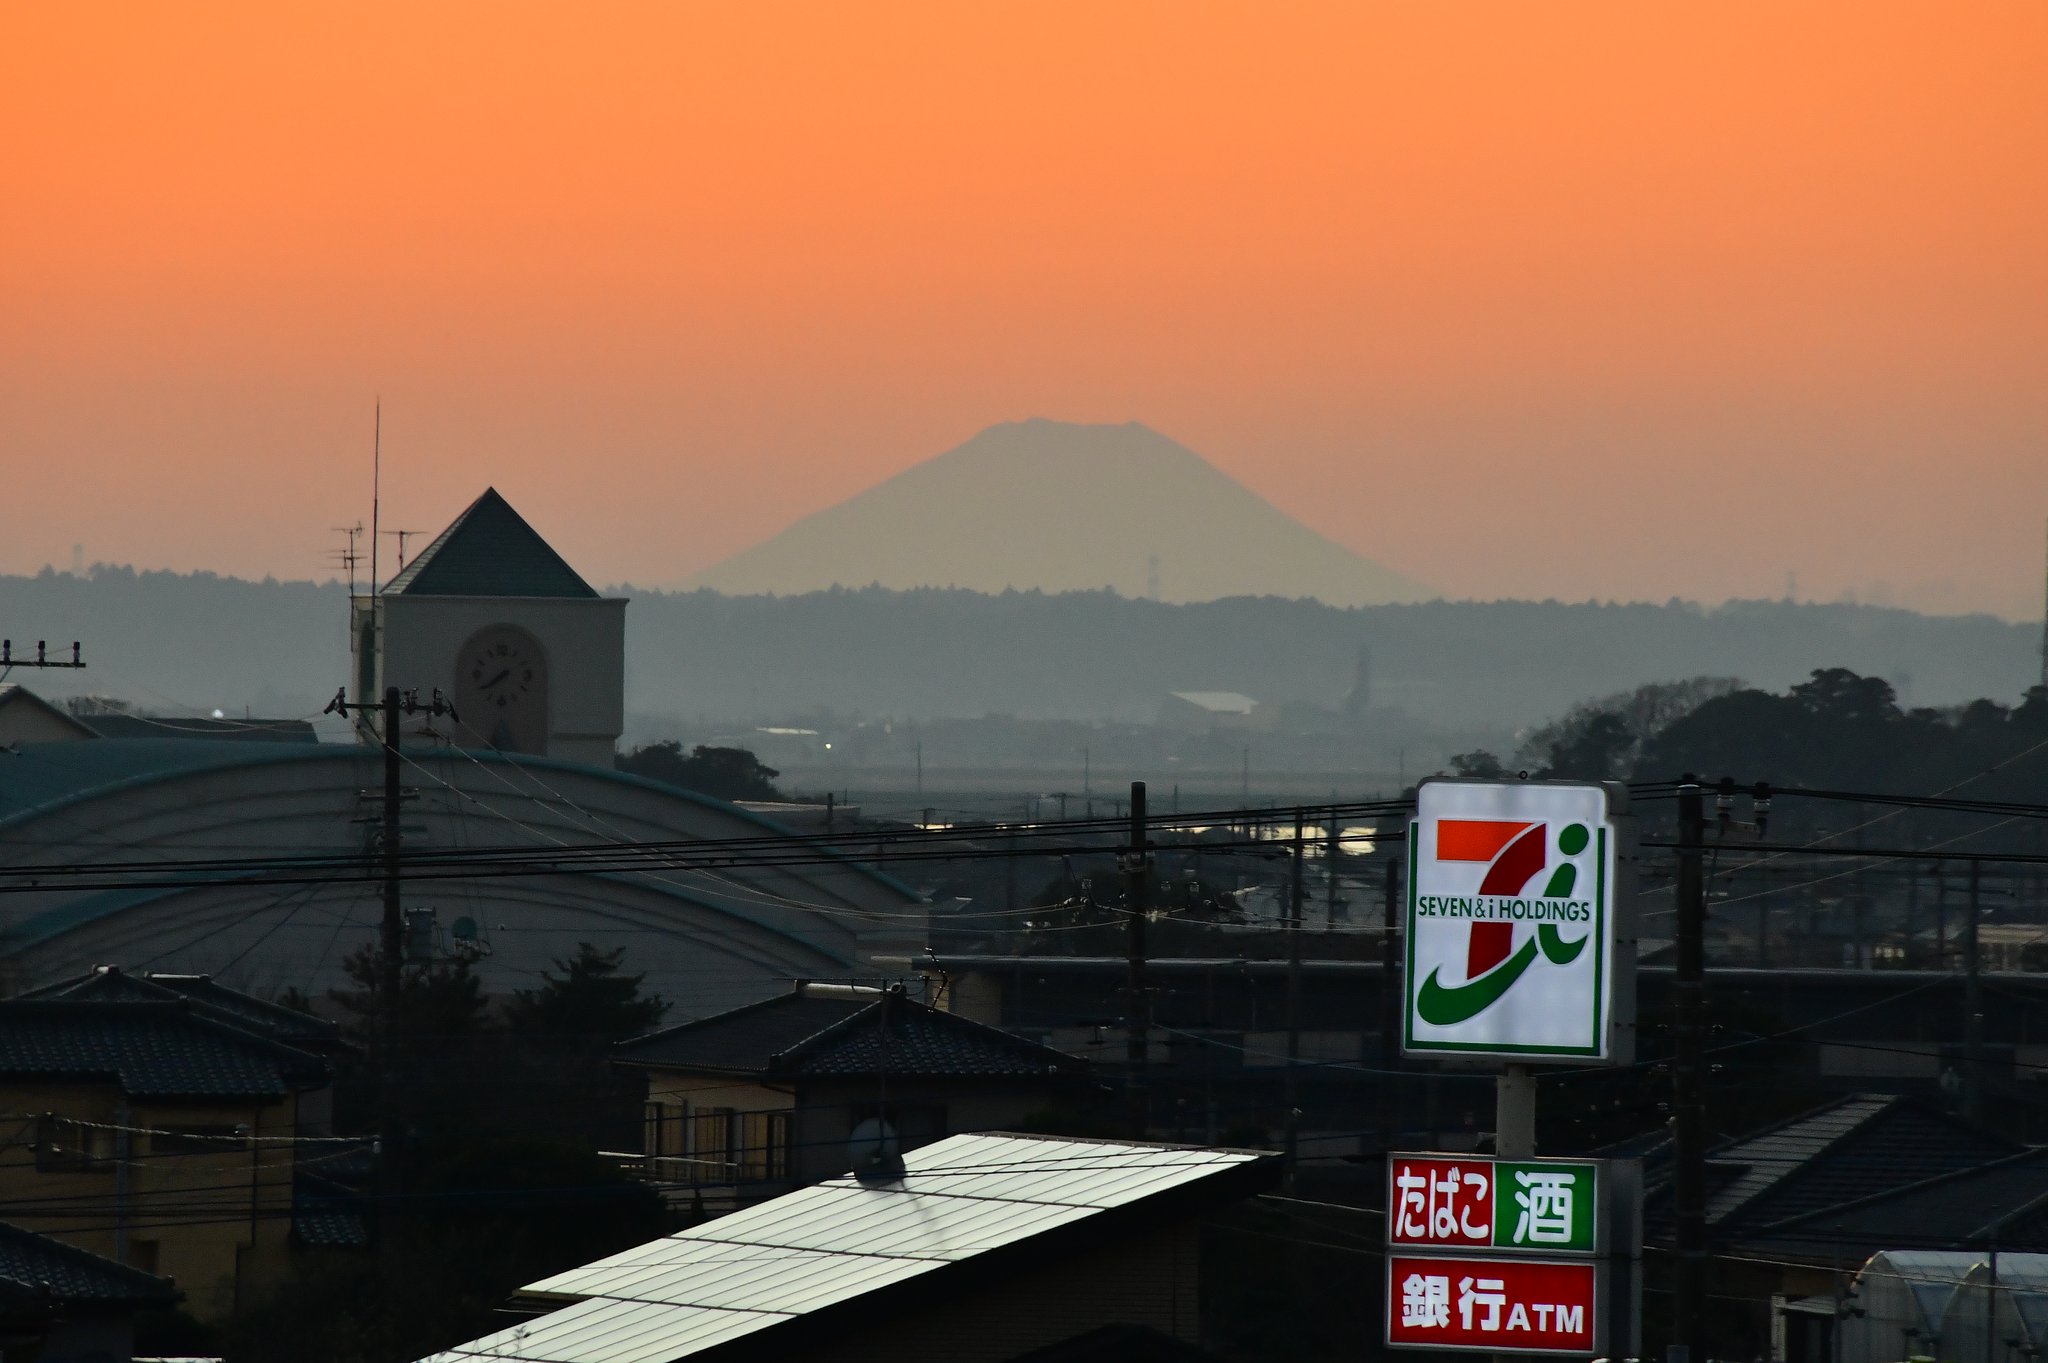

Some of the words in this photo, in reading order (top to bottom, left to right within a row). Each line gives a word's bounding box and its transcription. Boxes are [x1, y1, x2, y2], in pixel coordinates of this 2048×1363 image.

[1499, 899, 1591, 922] HOLDINGS
[1395, 1166, 1489, 1239] たばこ
[1512, 1170, 1576, 1244] 酒
